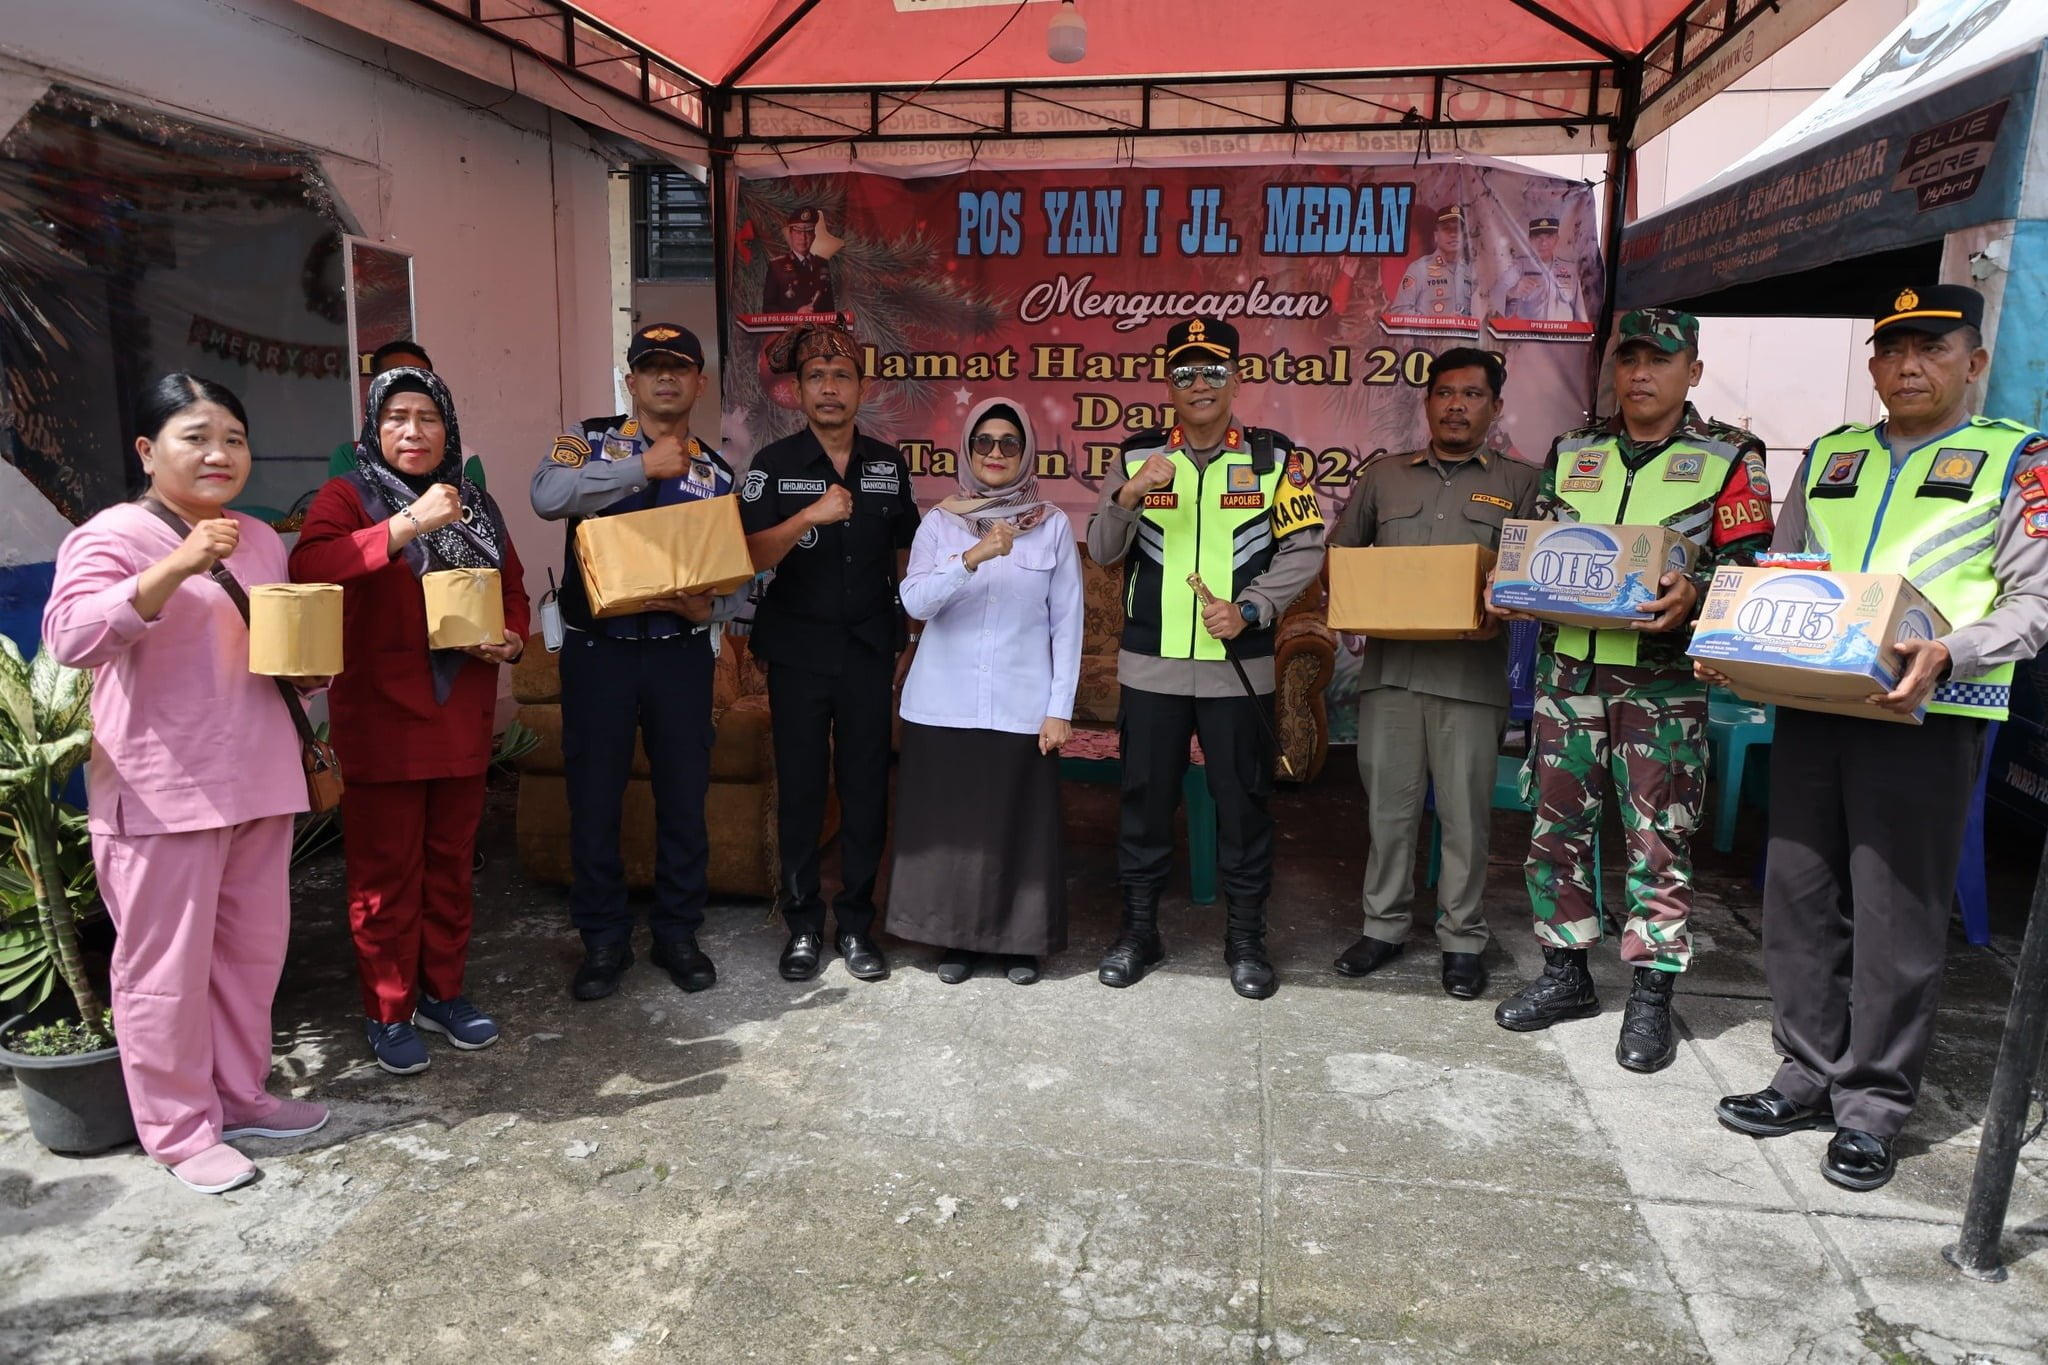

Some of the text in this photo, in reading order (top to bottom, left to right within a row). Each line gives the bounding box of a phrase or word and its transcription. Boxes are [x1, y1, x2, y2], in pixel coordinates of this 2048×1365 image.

[1915, 114, 1989, 155] BLUE
[1908, 147, 1980, 185] CORE
[1923, 174, 1976, 203] Hybrid
[957, 186, 1412, 256] POS YAN I JL. MEDAN
[1780, 215, 1803, 234] KEC.
[1845, 189, 1882, 215] TIMUR
[1020, 275, 1329, 330] Mengucapkan
[210, 330, 301, 368] MERRY
[862, 346, 1018, 378] lamat
[1032, 346, 1168, 380] Hari
[1240, 346, 1350, 382] atal
[902, 443, 1067, 477] Tan
[1144, 495, 1174, 507] OGEN
[1222, 494, 1262, 506] KAPOLRES
[1271, 502, 1293, 531] KA
[1502, 527, 1528, 542] SNI
[1530, 550, 1617, 590] OH5
[1713, 574, 1742, 589] SNI
[1581, 590, 1612, 598] Kemasan
[1737, 597, 1841, 641] OH5
[1792, 640, 1826, 650] Kemasan
